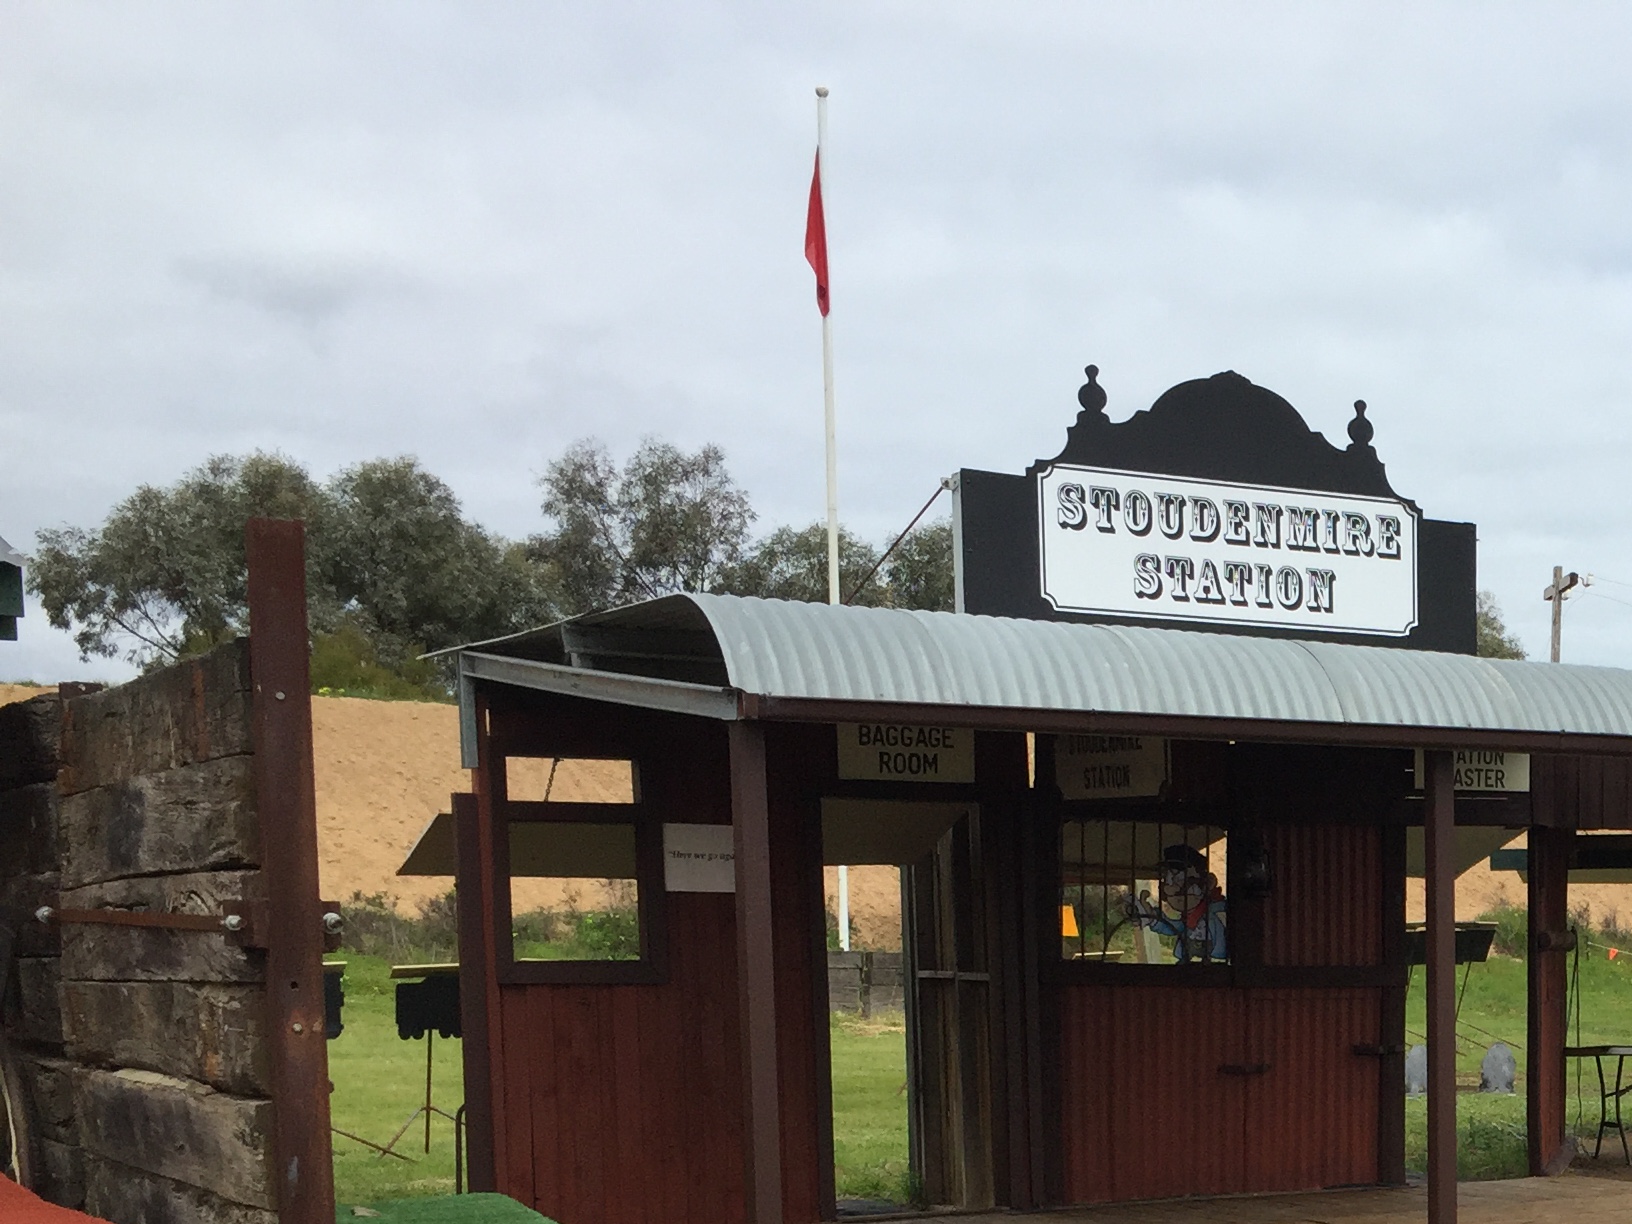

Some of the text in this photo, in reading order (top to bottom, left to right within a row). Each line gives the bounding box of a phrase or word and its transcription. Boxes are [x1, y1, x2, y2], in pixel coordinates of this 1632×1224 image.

[1057, 482, 1401, 560] STOUDENMIRE
[1134, 552, 1336, 614] STATION
[858, 725, 954, 749] BAGGAGE
[879, 752, 938, 774] ROOM
[1456, 751, 1505, 766] ATION
[1083, 765, 1130, 790] STATION
[1454, 768, 1505, 788] ASTER
